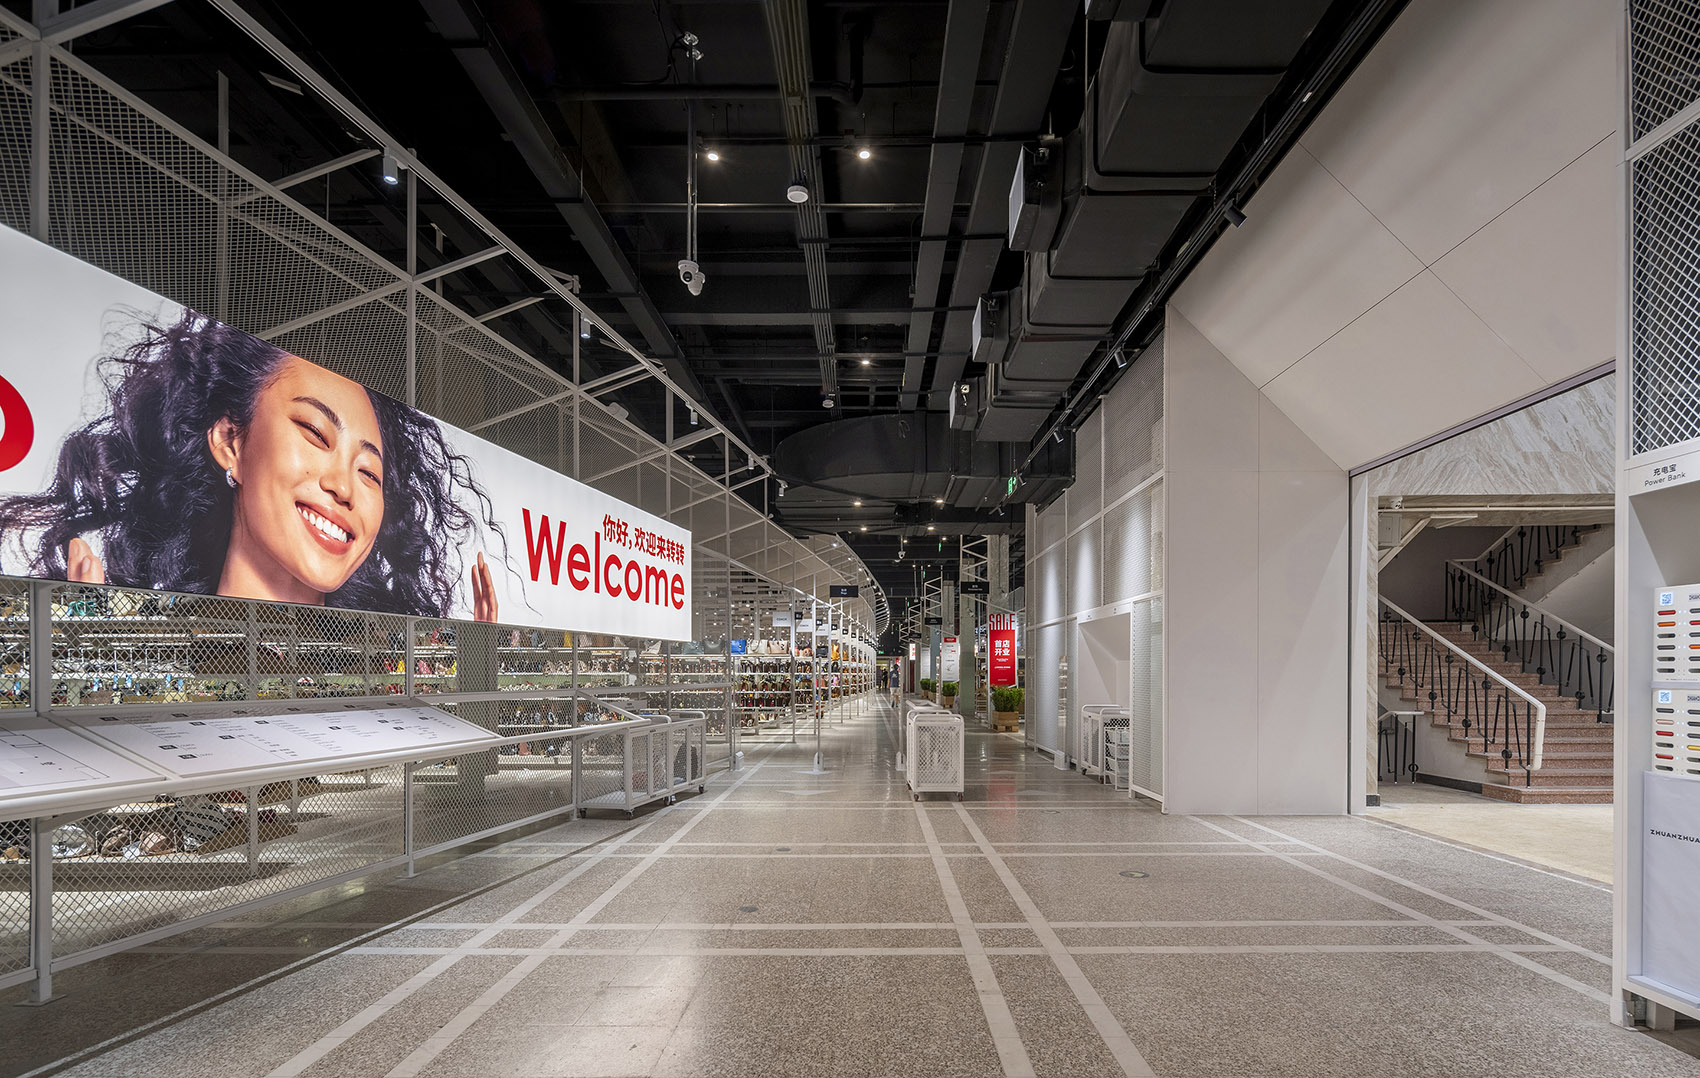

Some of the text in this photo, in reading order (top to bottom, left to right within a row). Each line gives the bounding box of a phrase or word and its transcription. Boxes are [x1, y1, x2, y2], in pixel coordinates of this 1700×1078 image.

[1653, 463, 1677, 476] 充电宝
[1644, 472, 1686, 487] Power Bank
[521, 507, 685, 610] Welcome
[989, 613, 1016, 631] SALE
[994, 639, 1010, 647] 首店
[994, 648, 1010, 656] 开业
[1650, 829, 1700, 844] ZHUANZHUA
